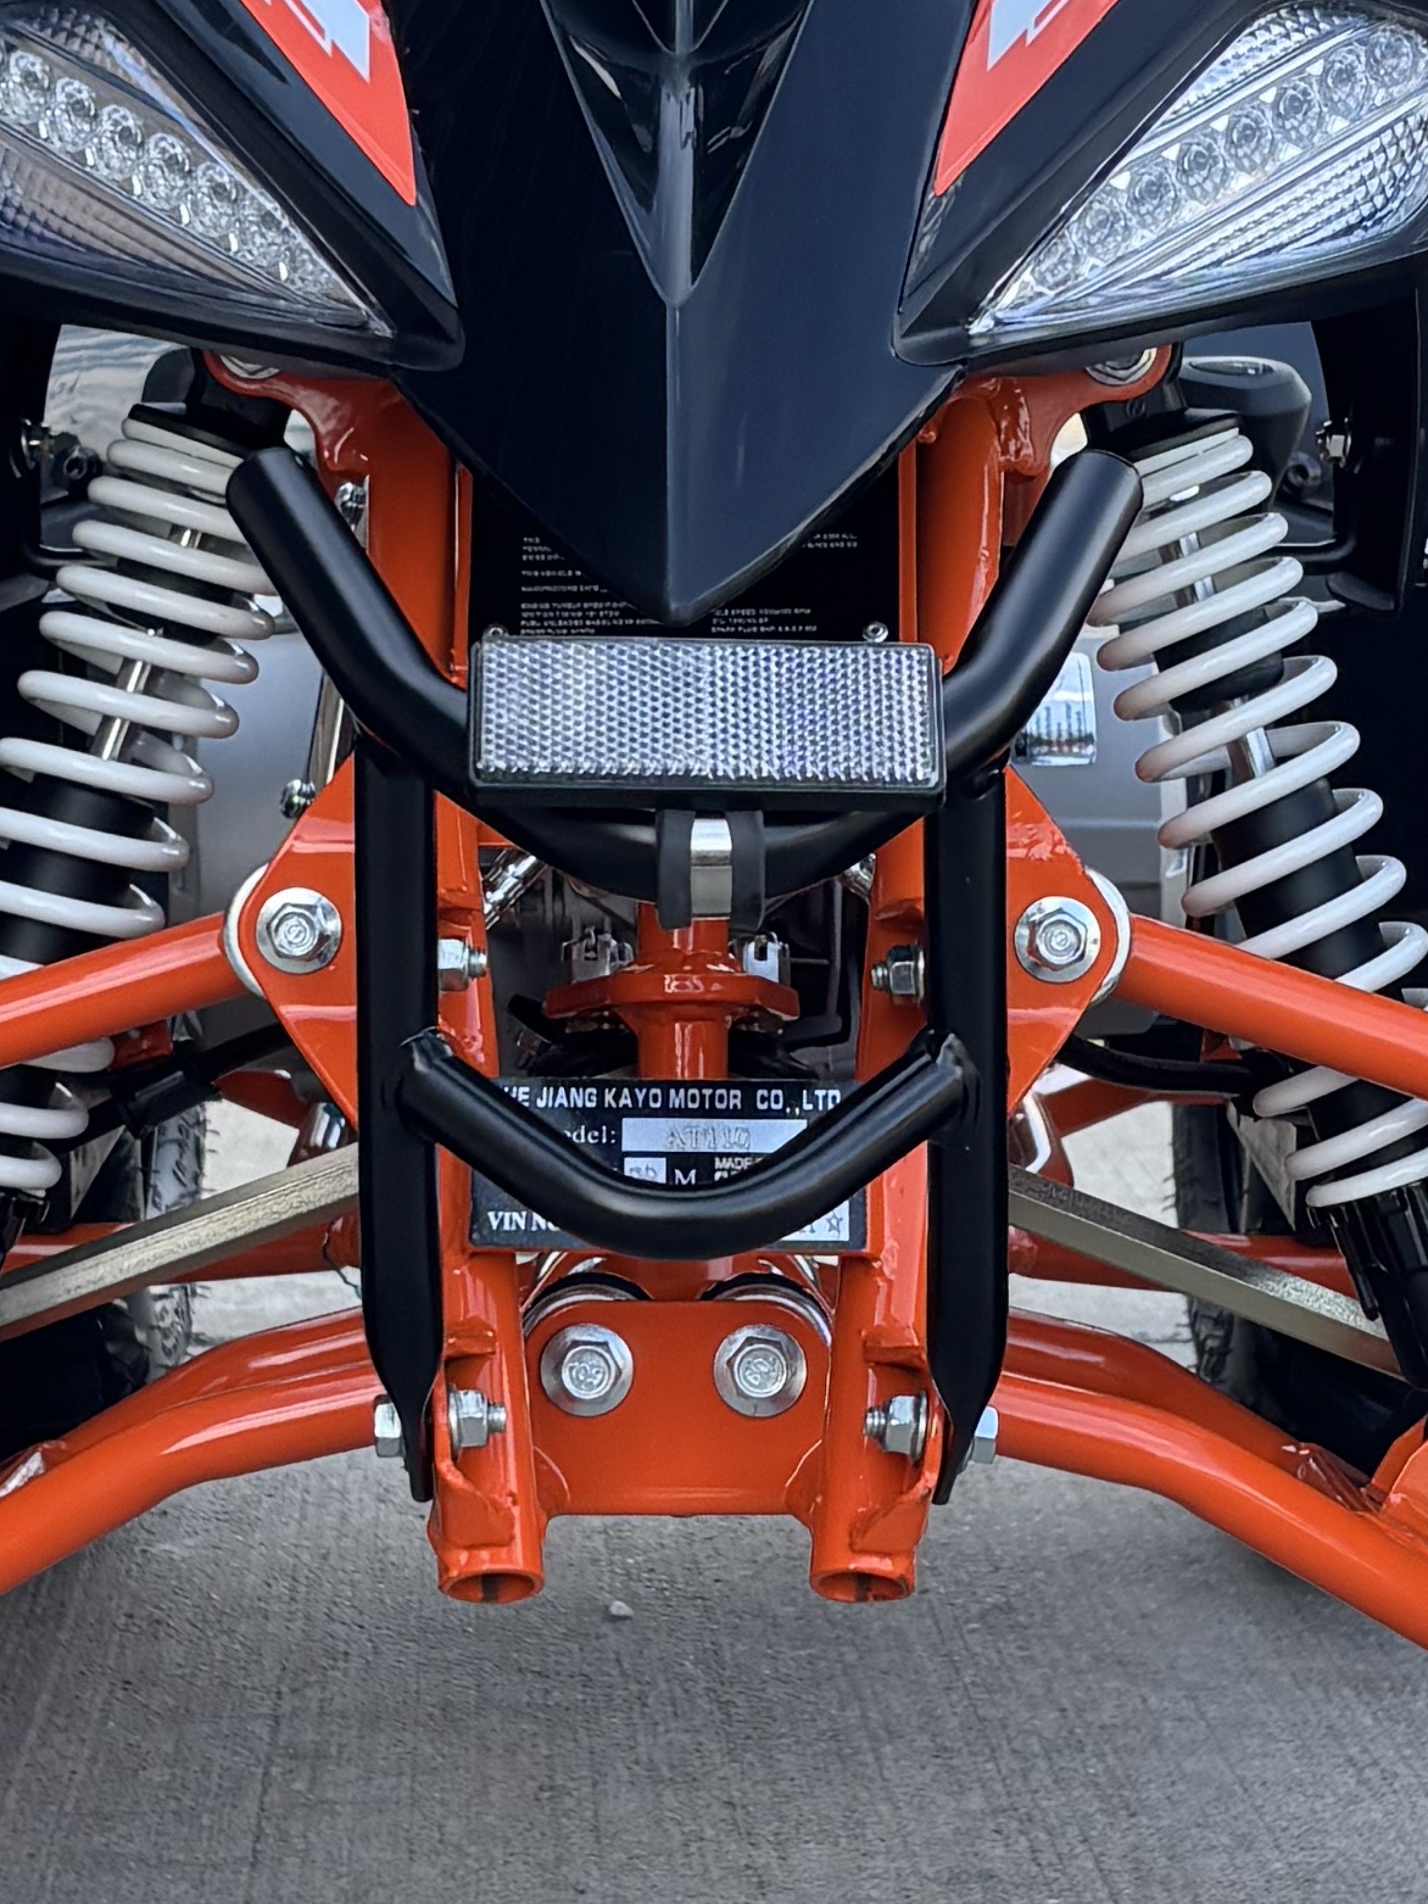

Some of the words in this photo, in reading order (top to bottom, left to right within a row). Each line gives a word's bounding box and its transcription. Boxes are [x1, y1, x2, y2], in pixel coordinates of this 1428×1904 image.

[536, 1086, 598, 1108] JIANG
[604, 1087, 662, 1109] KAYO
[669, 1088, 742, 1110] MOTOR
[663, 1125, 752, 1150] AT110
[487, 1211, 527, 1231] VIN
